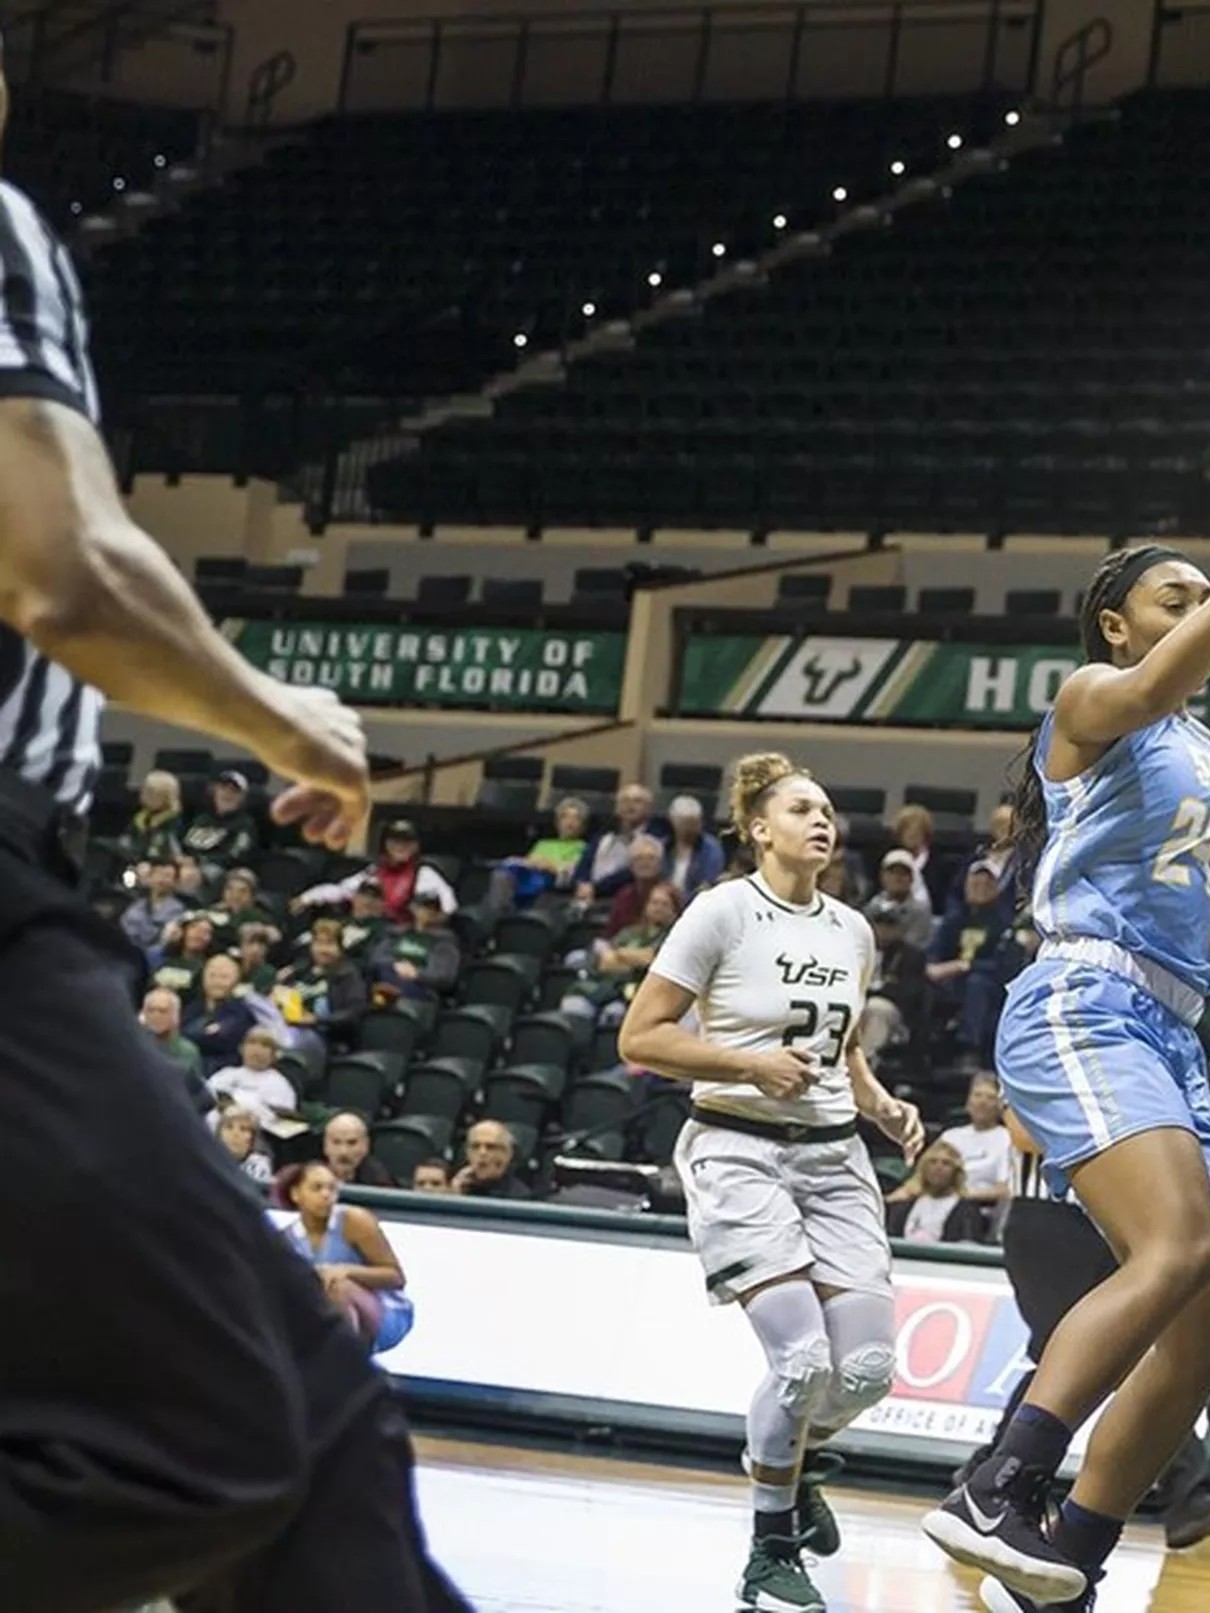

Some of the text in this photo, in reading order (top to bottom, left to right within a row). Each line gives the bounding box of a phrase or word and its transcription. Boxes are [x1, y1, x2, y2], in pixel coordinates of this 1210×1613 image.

[272, 629, 593, 667] UNIVERSITY OF
[268, 658, 588, 698] SOUTH FLORIDA
[775, 952, 848, 987] USF
[782, 1000, 851, 1068] 23
